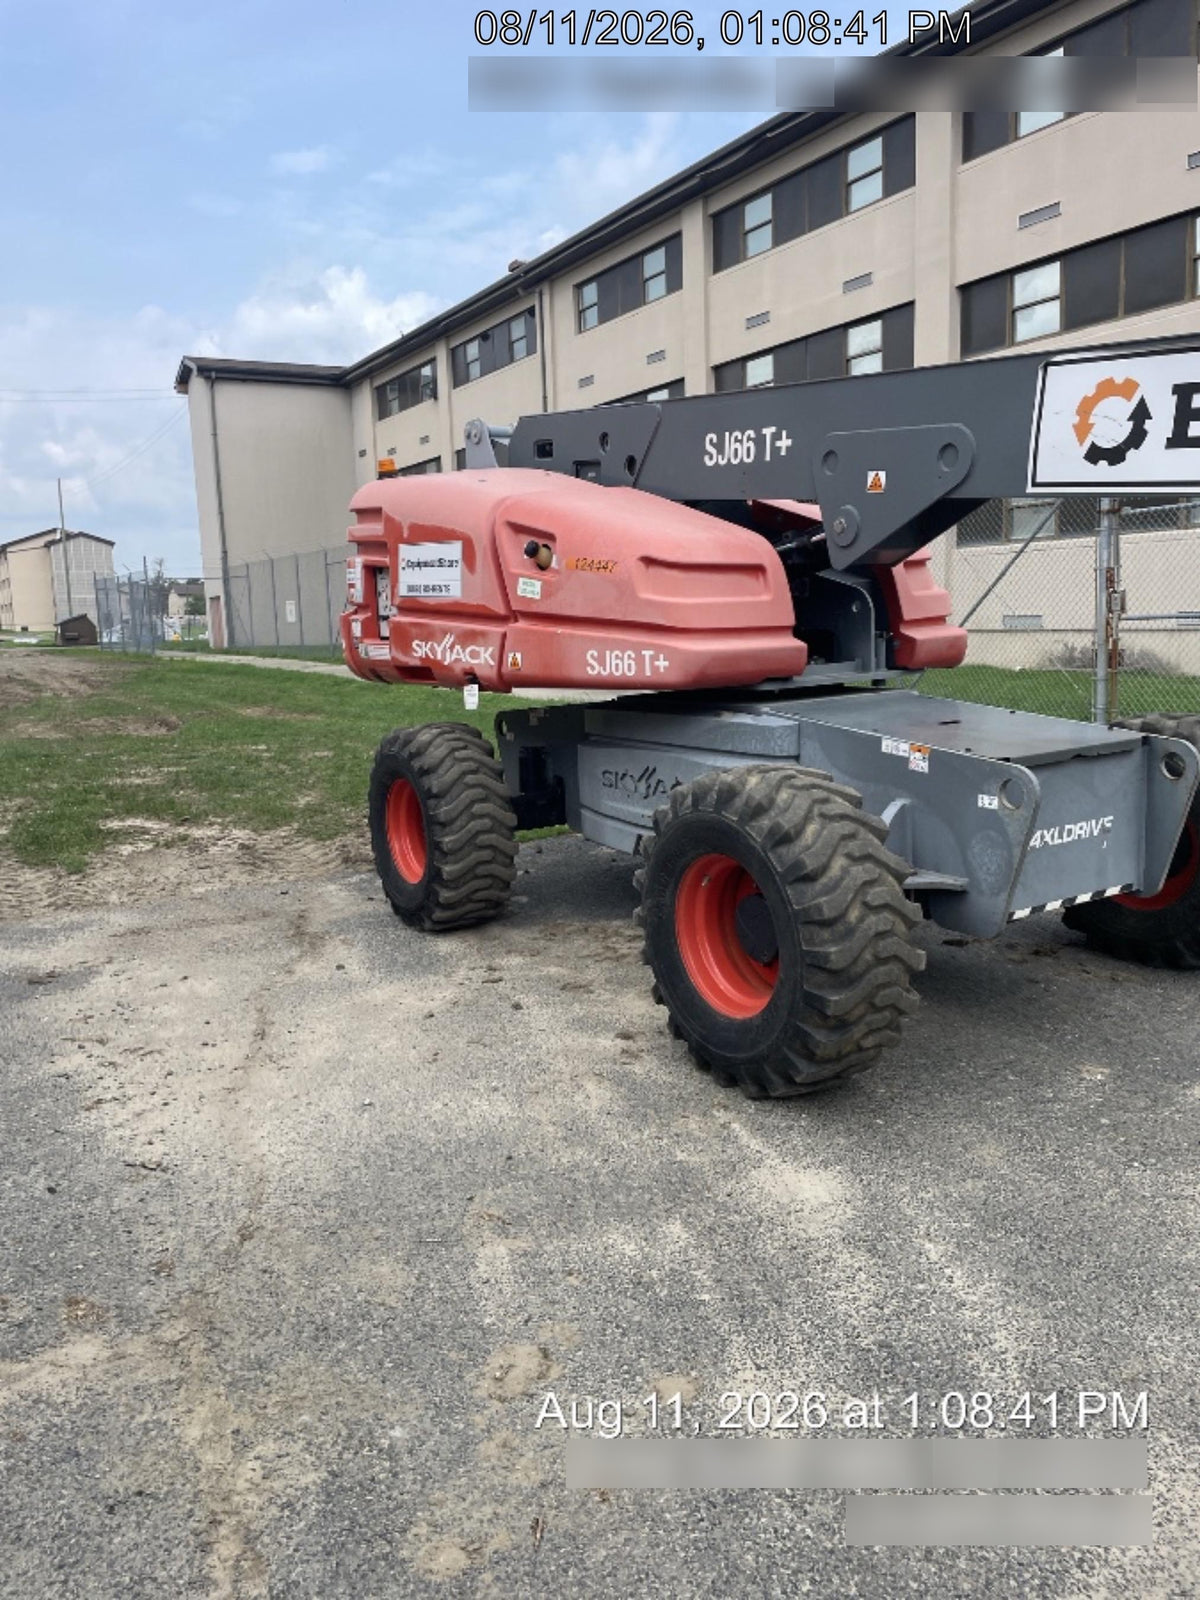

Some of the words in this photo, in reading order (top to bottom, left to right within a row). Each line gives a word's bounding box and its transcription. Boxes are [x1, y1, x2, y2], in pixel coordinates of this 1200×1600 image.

[703, 430, 756, 467] SJ66
[762, 426, 793, 462] T+
[411, 632, 496, 666] SKYJACK
[585, 649, 637, 677] SJ66
[640, 650, 670, 677] T+
